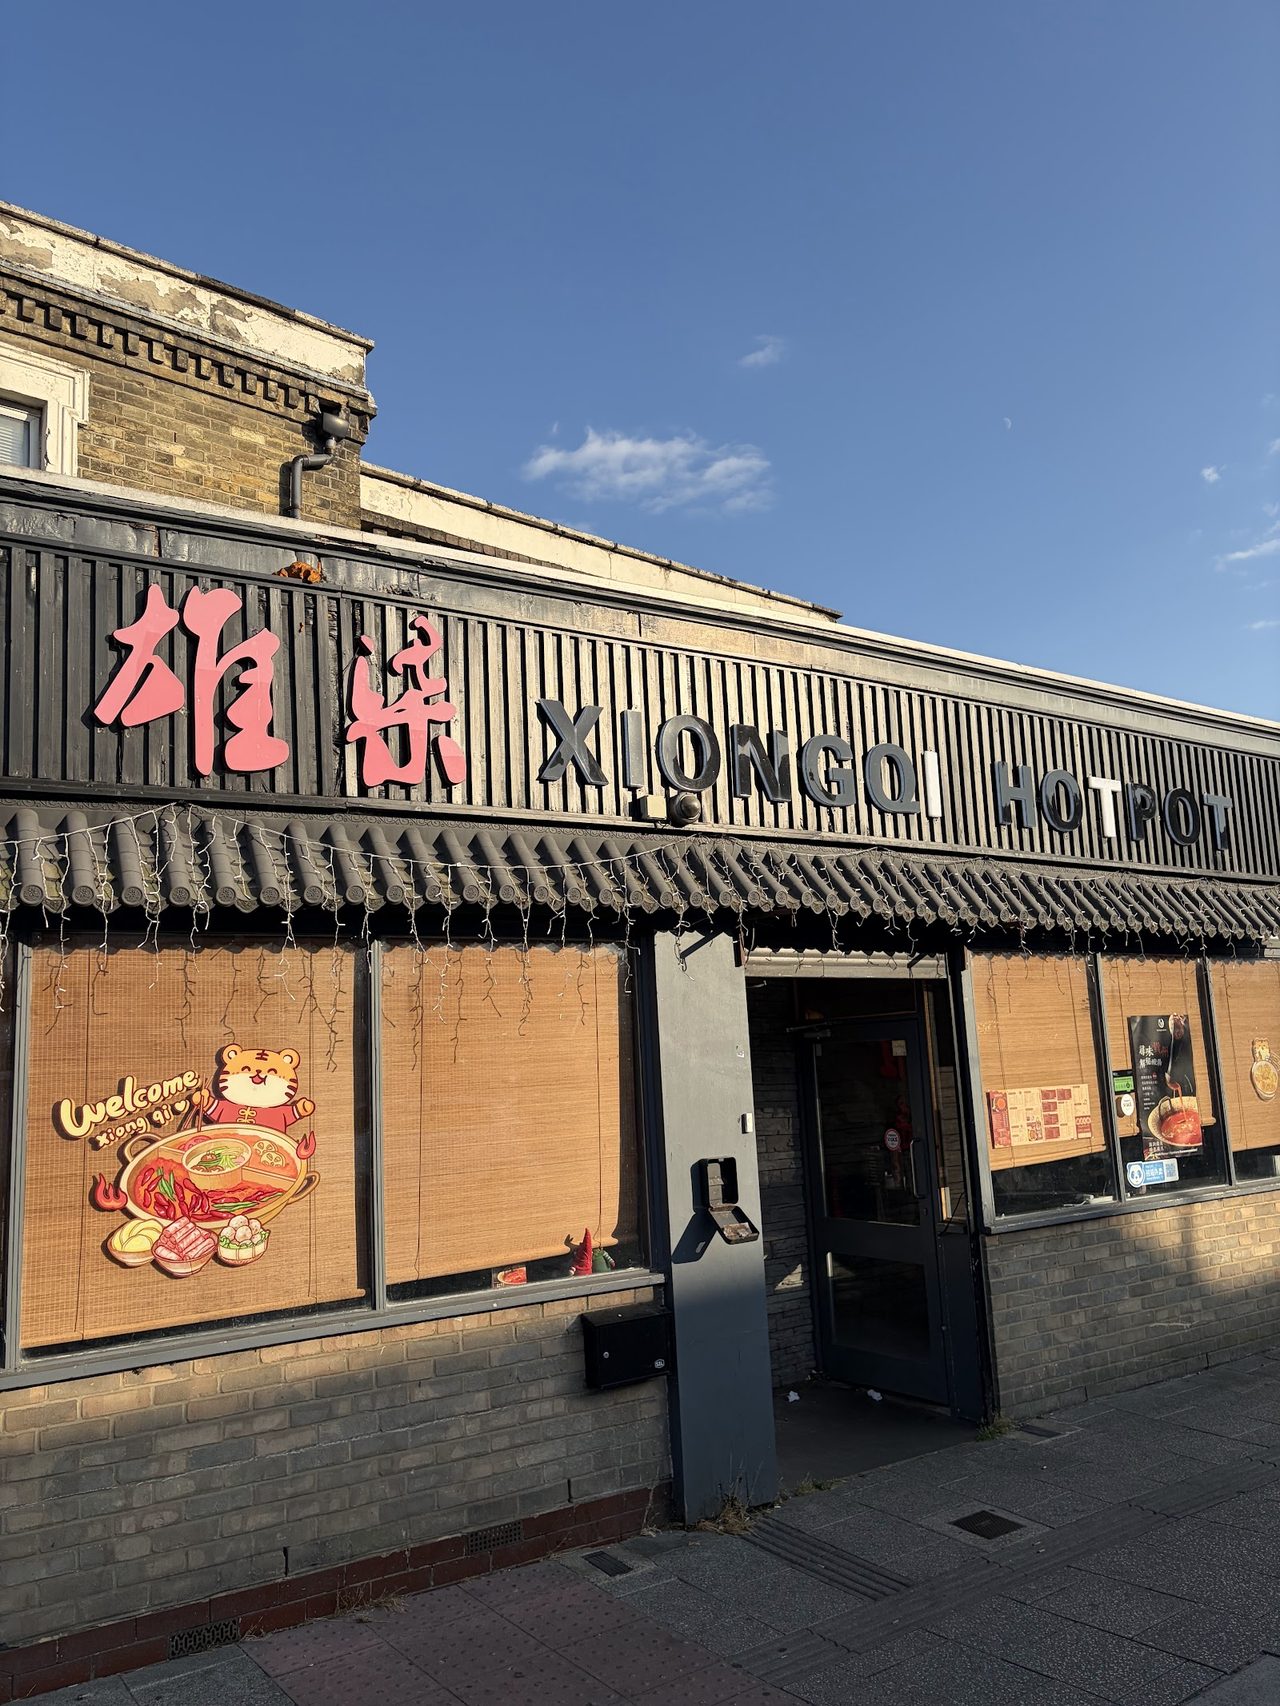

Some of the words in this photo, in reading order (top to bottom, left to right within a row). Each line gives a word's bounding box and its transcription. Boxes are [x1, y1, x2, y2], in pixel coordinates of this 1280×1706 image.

[537, 698, 942, 819] XIONGQI
[994, 760, 1232, 850] HOTPOT
[96, 1117, 148, 1147] xiong
[152, 1104, 173, 1125] qi
